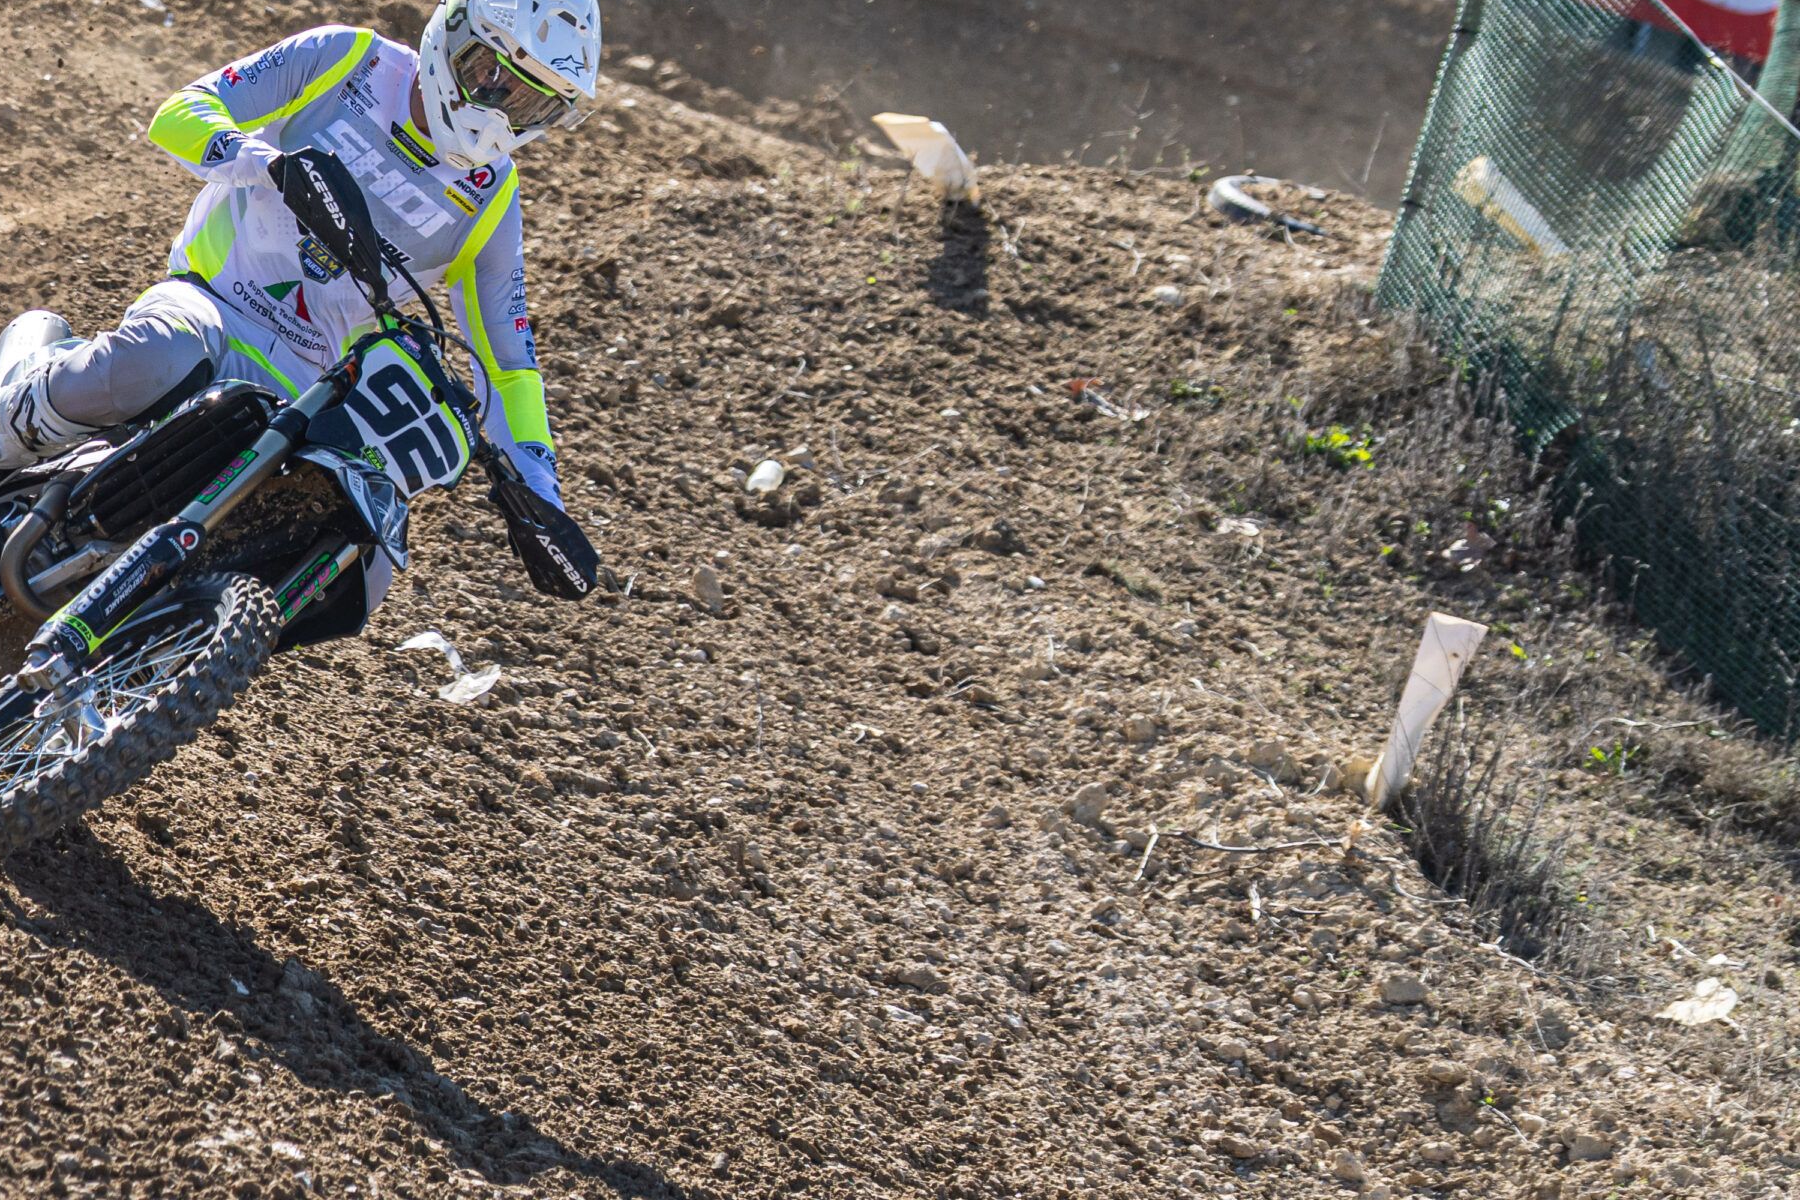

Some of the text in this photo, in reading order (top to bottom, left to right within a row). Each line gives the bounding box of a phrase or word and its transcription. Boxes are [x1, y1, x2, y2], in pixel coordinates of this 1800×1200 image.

[338, 91, 365, 115] SRG
[397, 130, 437, 165] PERFORMANCE
[299, 157, 347, 231] ACERBIS
[313, 119, 457, 238] SHOT
[451, 191, 475, 214] DUNLOP
[303, 257, 326, 278] RUEDA
[305, 240, 343, 274] TEAM
[233, 281, 328, 354] Oversupension
[278, 303, 322, 338] Technology
[354, 363, 462, 495] 52
[452, 405, 477, 447] ANDER
[365, 450, 385, 472] TEAM
[77, 530, 161, 615] DUNLOP
[537, 533, 589, 593] ACERBIS
[104, 568, 148, 617] PERFORMANCE
